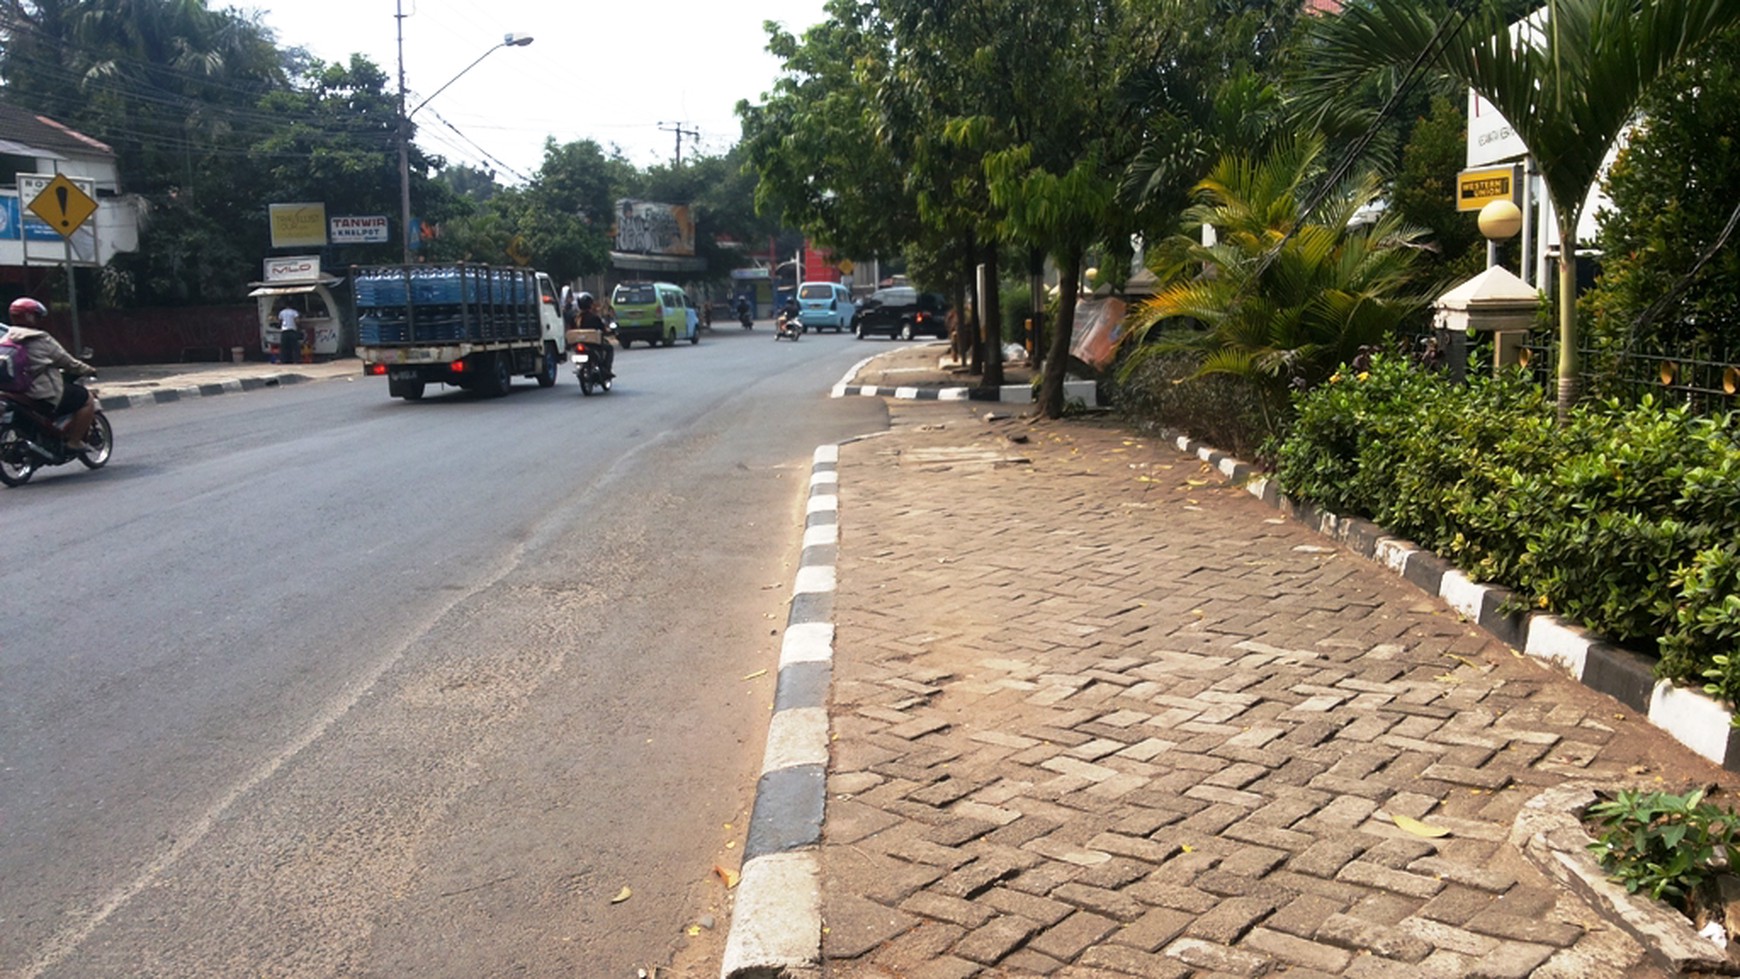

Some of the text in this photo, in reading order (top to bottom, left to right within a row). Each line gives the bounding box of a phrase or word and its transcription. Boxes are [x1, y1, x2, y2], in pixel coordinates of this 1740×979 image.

[1462, 180, 1501, 191] WESTERN
[1474, 187, 1501, 197] UNION
[333, 217, 386, 228] TANWIR
